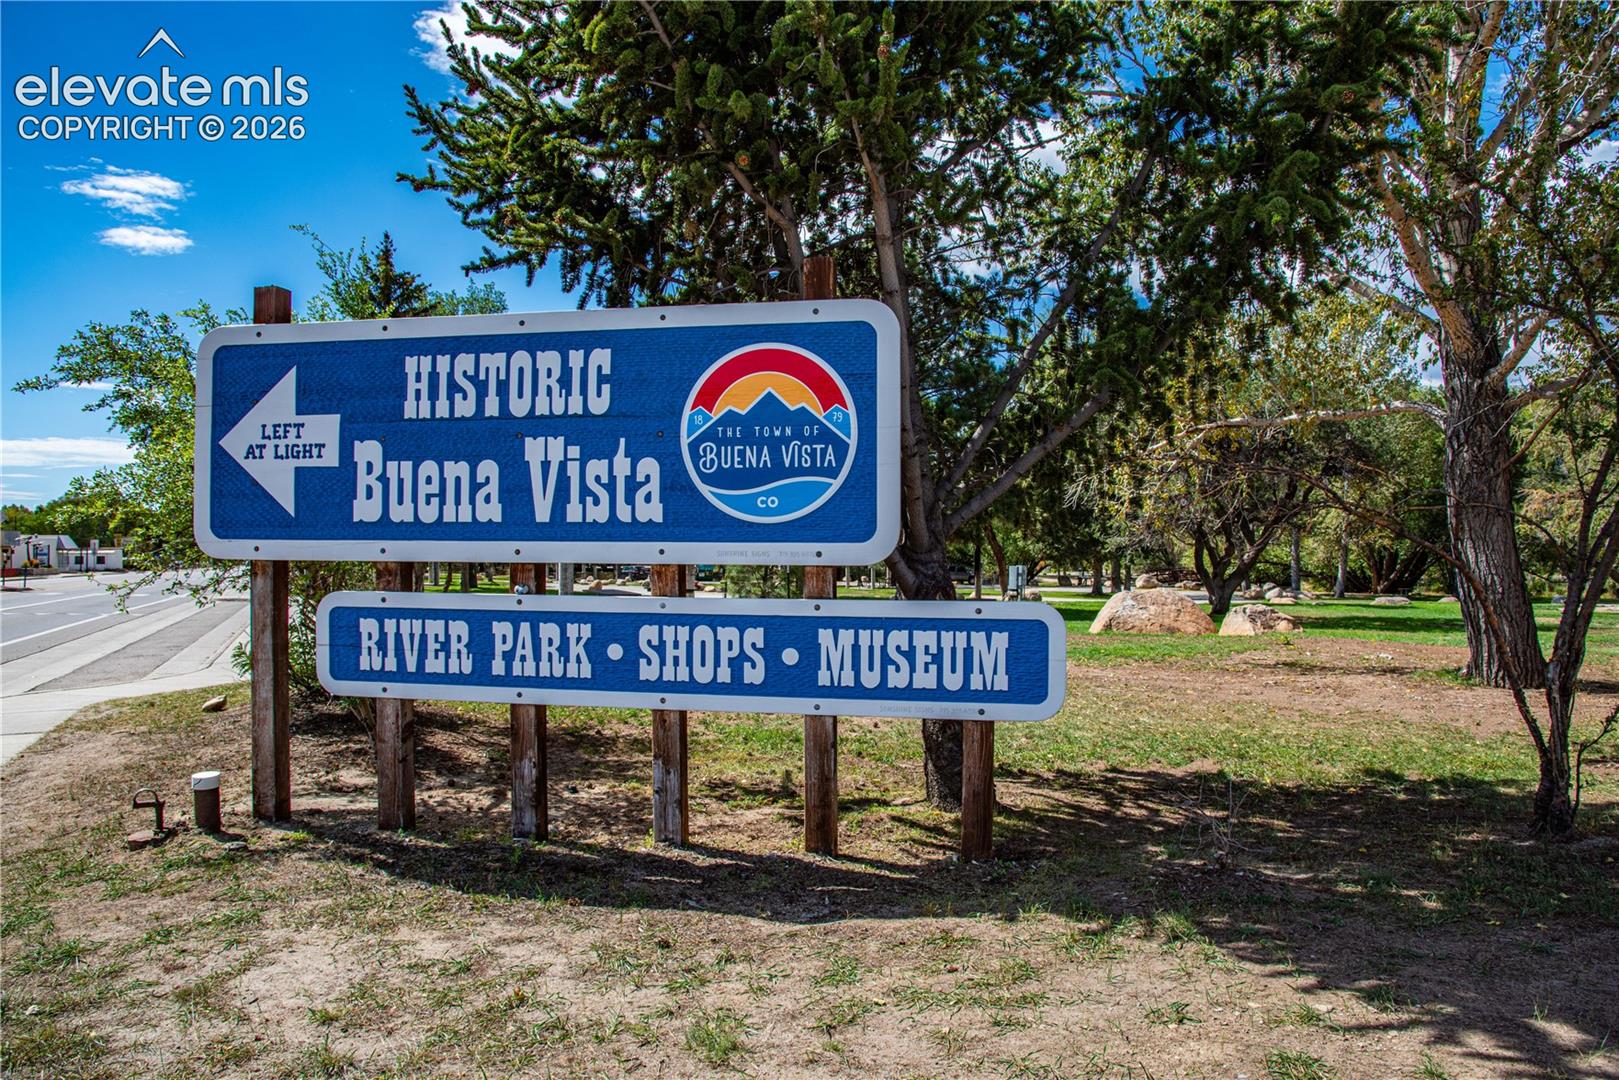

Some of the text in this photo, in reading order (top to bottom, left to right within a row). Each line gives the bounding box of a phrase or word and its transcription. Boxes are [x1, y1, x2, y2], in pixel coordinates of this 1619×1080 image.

[403, 348, 612, 419] HISTORIC
[694, 415, 703, 425] 18
[832, 412, 843, 422] 79
[261, 423, 305, 440] LEFT
[717, 425, 819, 438] THE TOWN OF
[244, 443, 326, 460] AT LIGHT
[699, 440, 836, 473] BUENA VISTA
[353, 436, 663, 523] Buena Vista
[756, 496, 779, 508] CO
[359, 617, 1010, 692] RIVER PARK SHOPS MUSEUM
